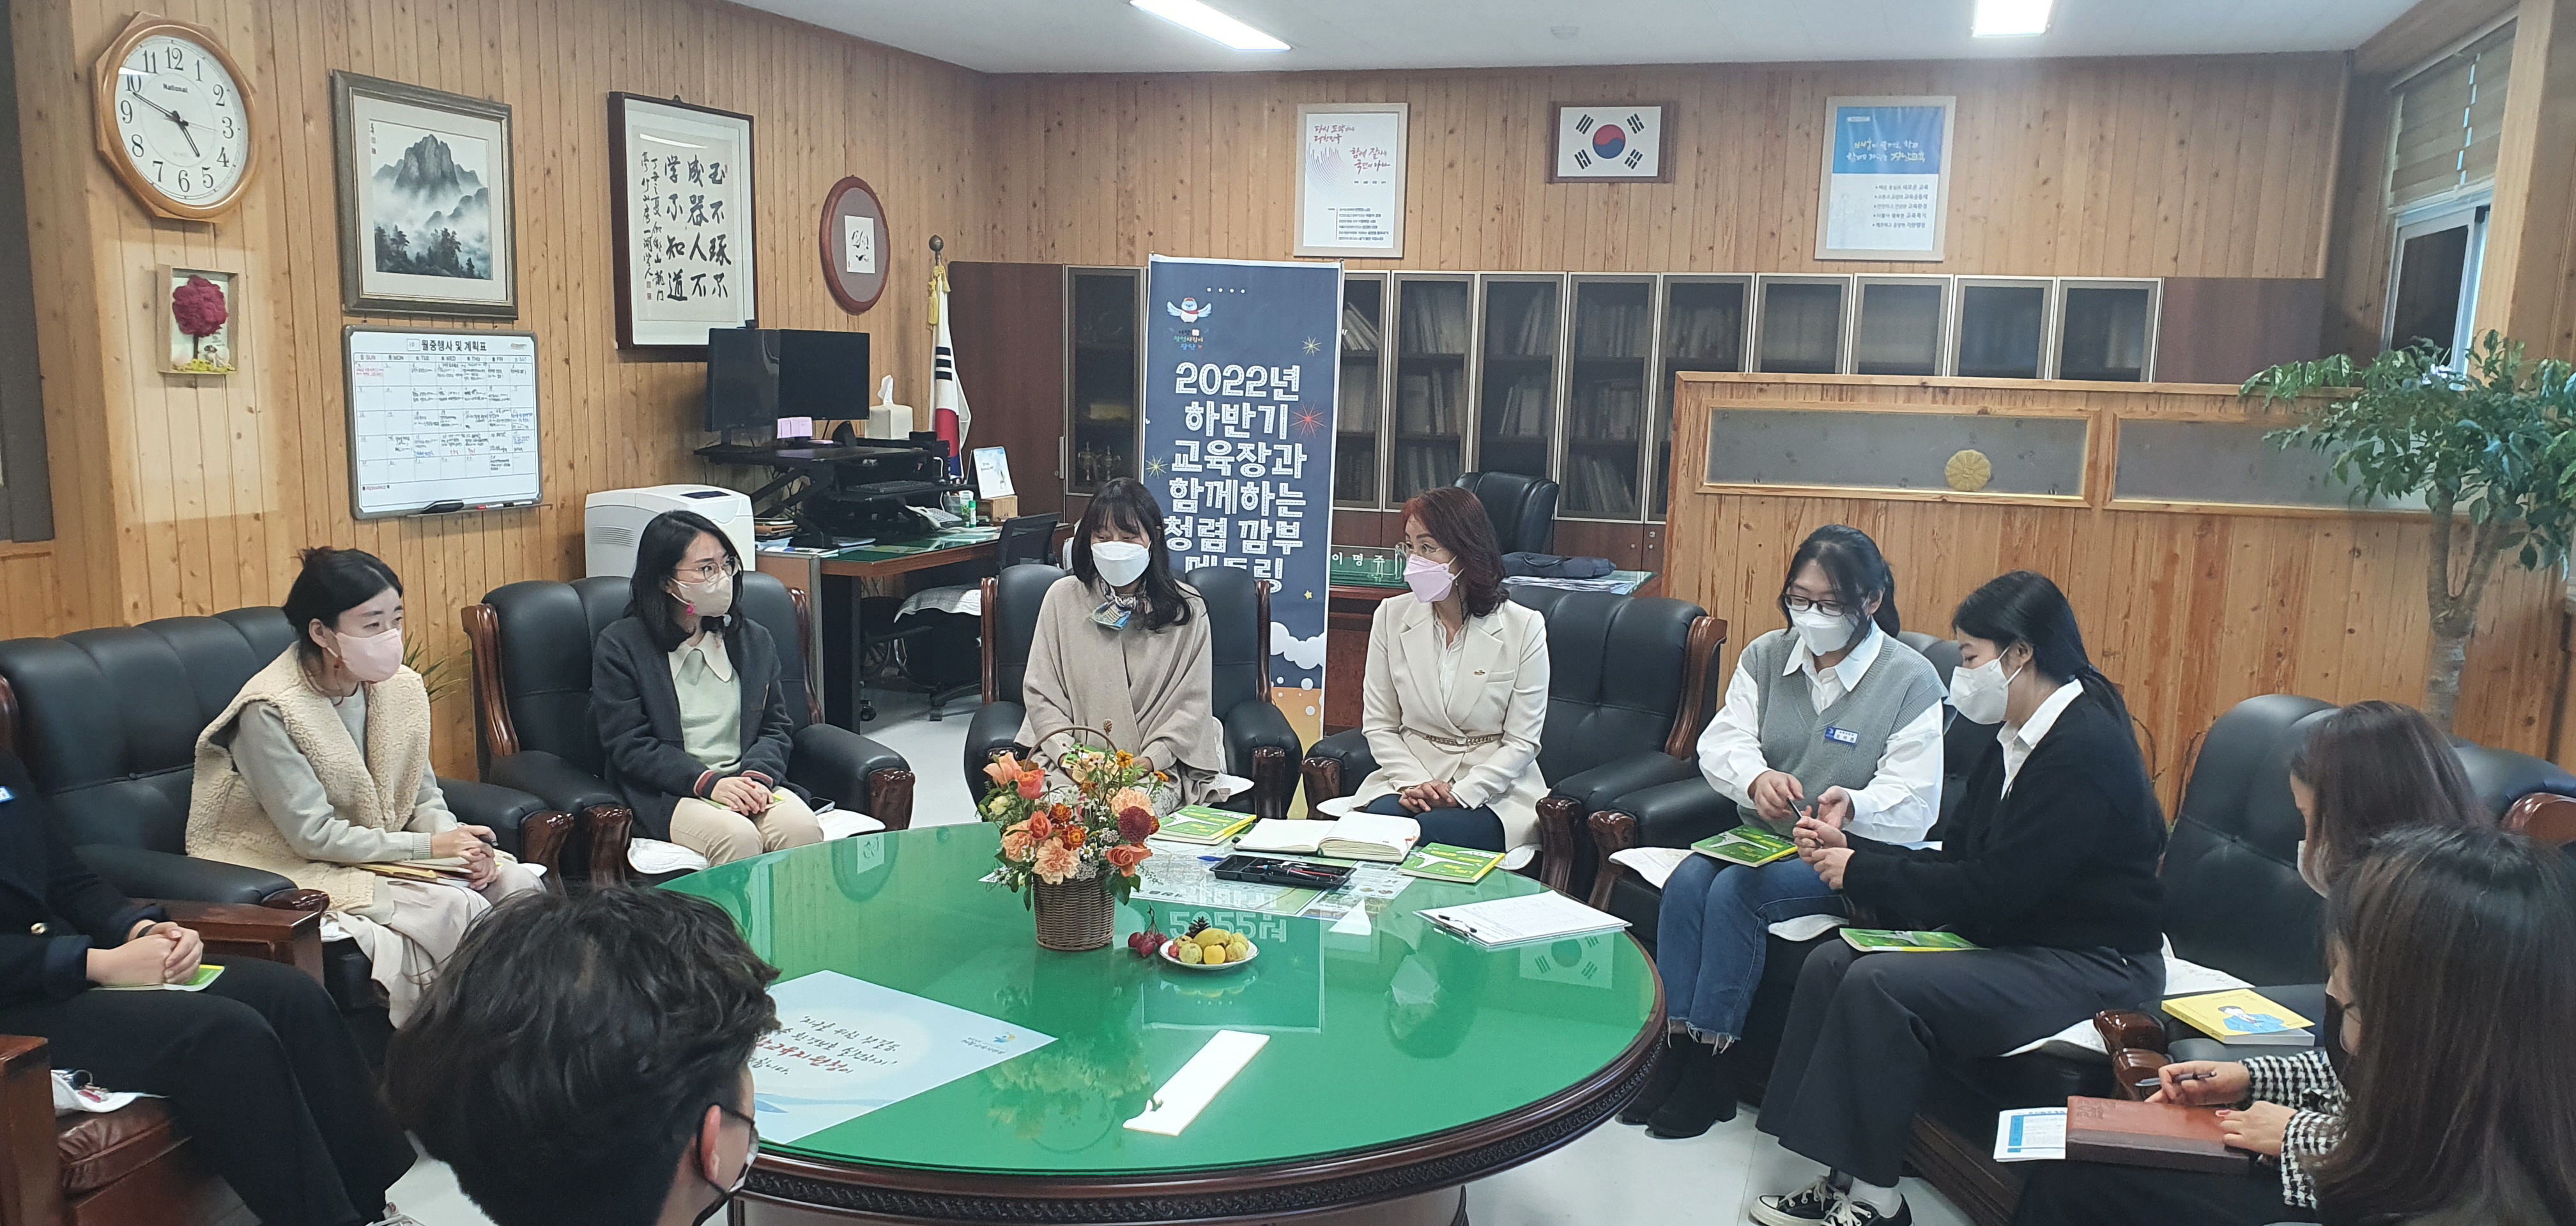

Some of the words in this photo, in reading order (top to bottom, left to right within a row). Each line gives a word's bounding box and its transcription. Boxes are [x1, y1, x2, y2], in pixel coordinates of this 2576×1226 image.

[142, 50, 158, 74] 11
[165, 46, 183, 71] 12
[194, 59, 203, 82] 1
[125, 74, 142, 93] 10
[162, 83, 188, 93] National
[213, 84, 225, 107] 2
[120, 100, 133, 123] 9
[222, 116, 234, 139] 3
[1314, 125, 1330, 134] 다시
[1314, 134, 1342, 144] 대한민국
[131, 134, 144, 157] 8
[216, 146, 229, 168] 4
[1349, 147, 1367, 158] 함께
[152, 160, 164, 183] 7
[201, 166, 214, 188] 5
[1374, 159, 1391, 172] 나라
[178, 169, 190, 192] 6
[422, 339, 453, 351] 월중행사
[456, 341, 463, 351] 및
[464, 341, 487, 352] 계획표
[1175, 362, 1301, 402] 2022년
[1184, 400, 1289, 440] 하반기
[1171, 440, 1308, 479] 교육장과
[1169, 477, 1307, 518] 함께하는
[1163, 515, 1228, 553] 청렴
[1238, 518, 1303, 555] 깜부
[791, 1032, 839, 1051] 환경보호
[834, 1029, 860, 1039] 위한
[861, 1035, 879, 1044] 첫
